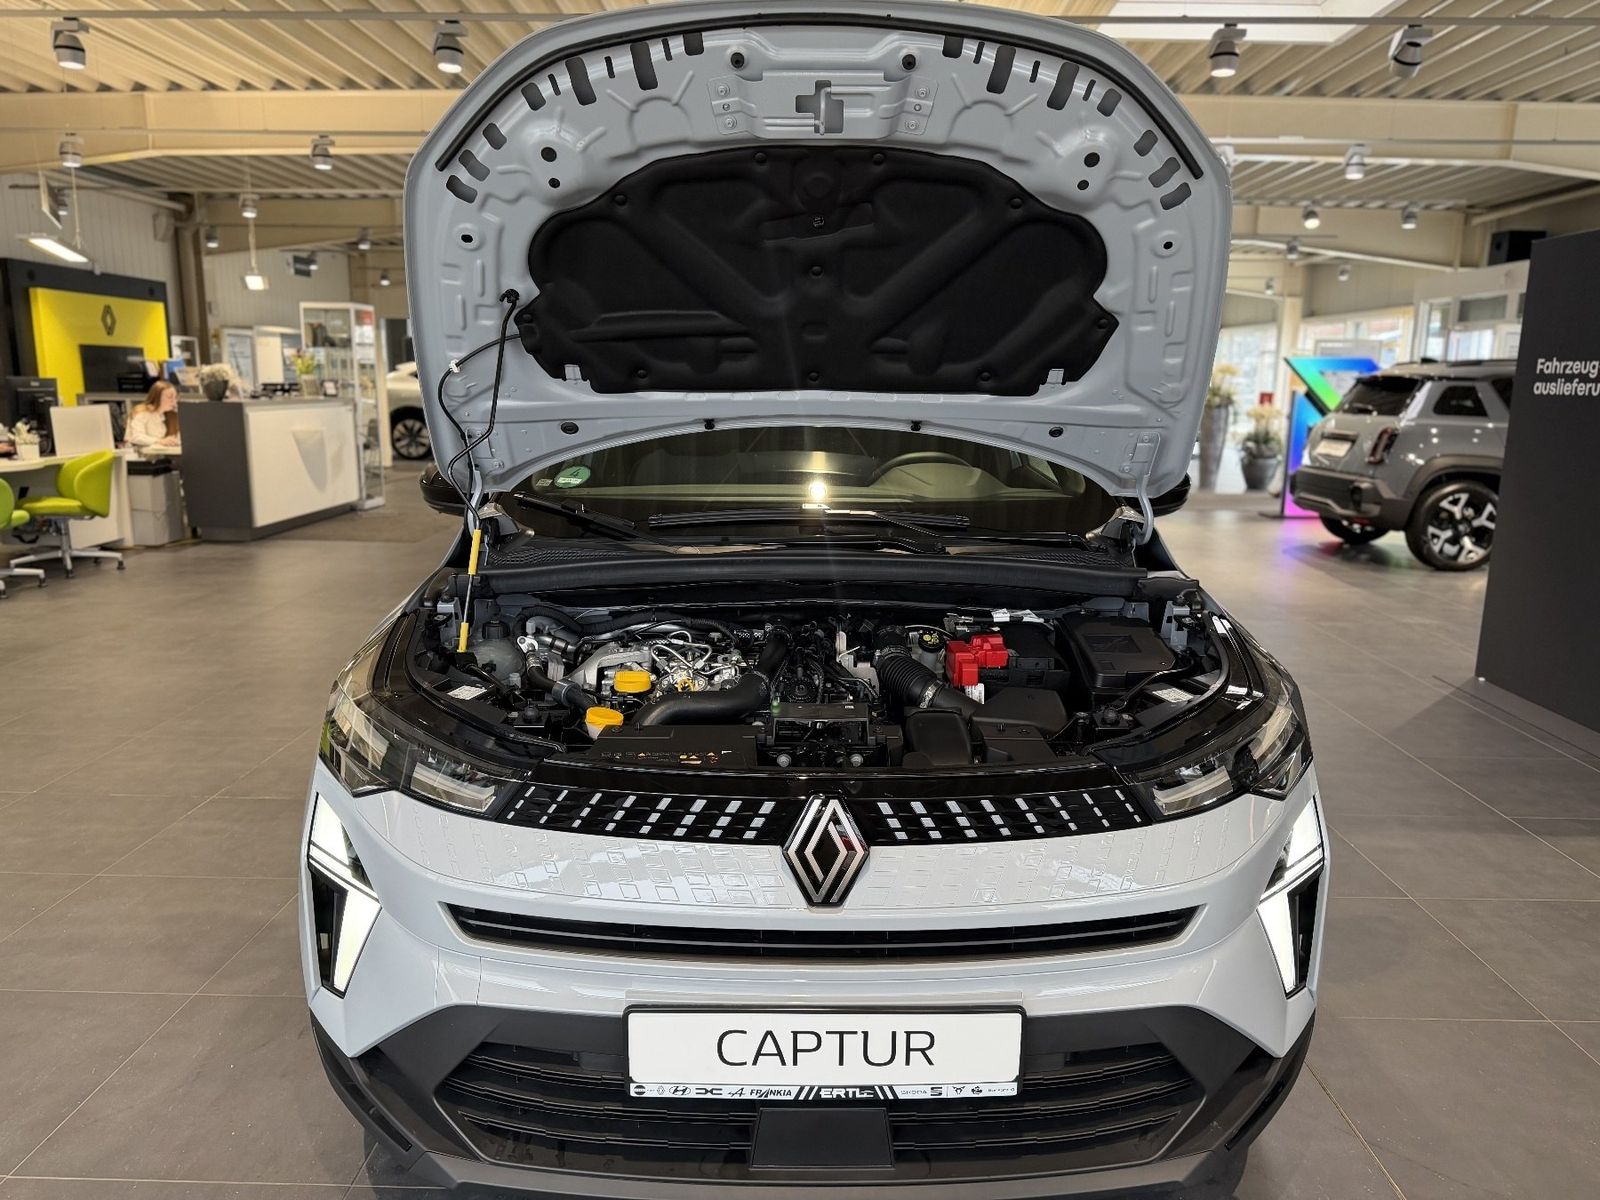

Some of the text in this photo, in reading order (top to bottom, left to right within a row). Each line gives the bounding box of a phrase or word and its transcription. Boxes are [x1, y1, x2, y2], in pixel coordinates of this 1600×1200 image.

[1536, 357, 1600, 378] Fahrzeug
[717, 1029, 935, 1067] CAPTUR
[750, 1087, 792, 1098] FRANKIA
